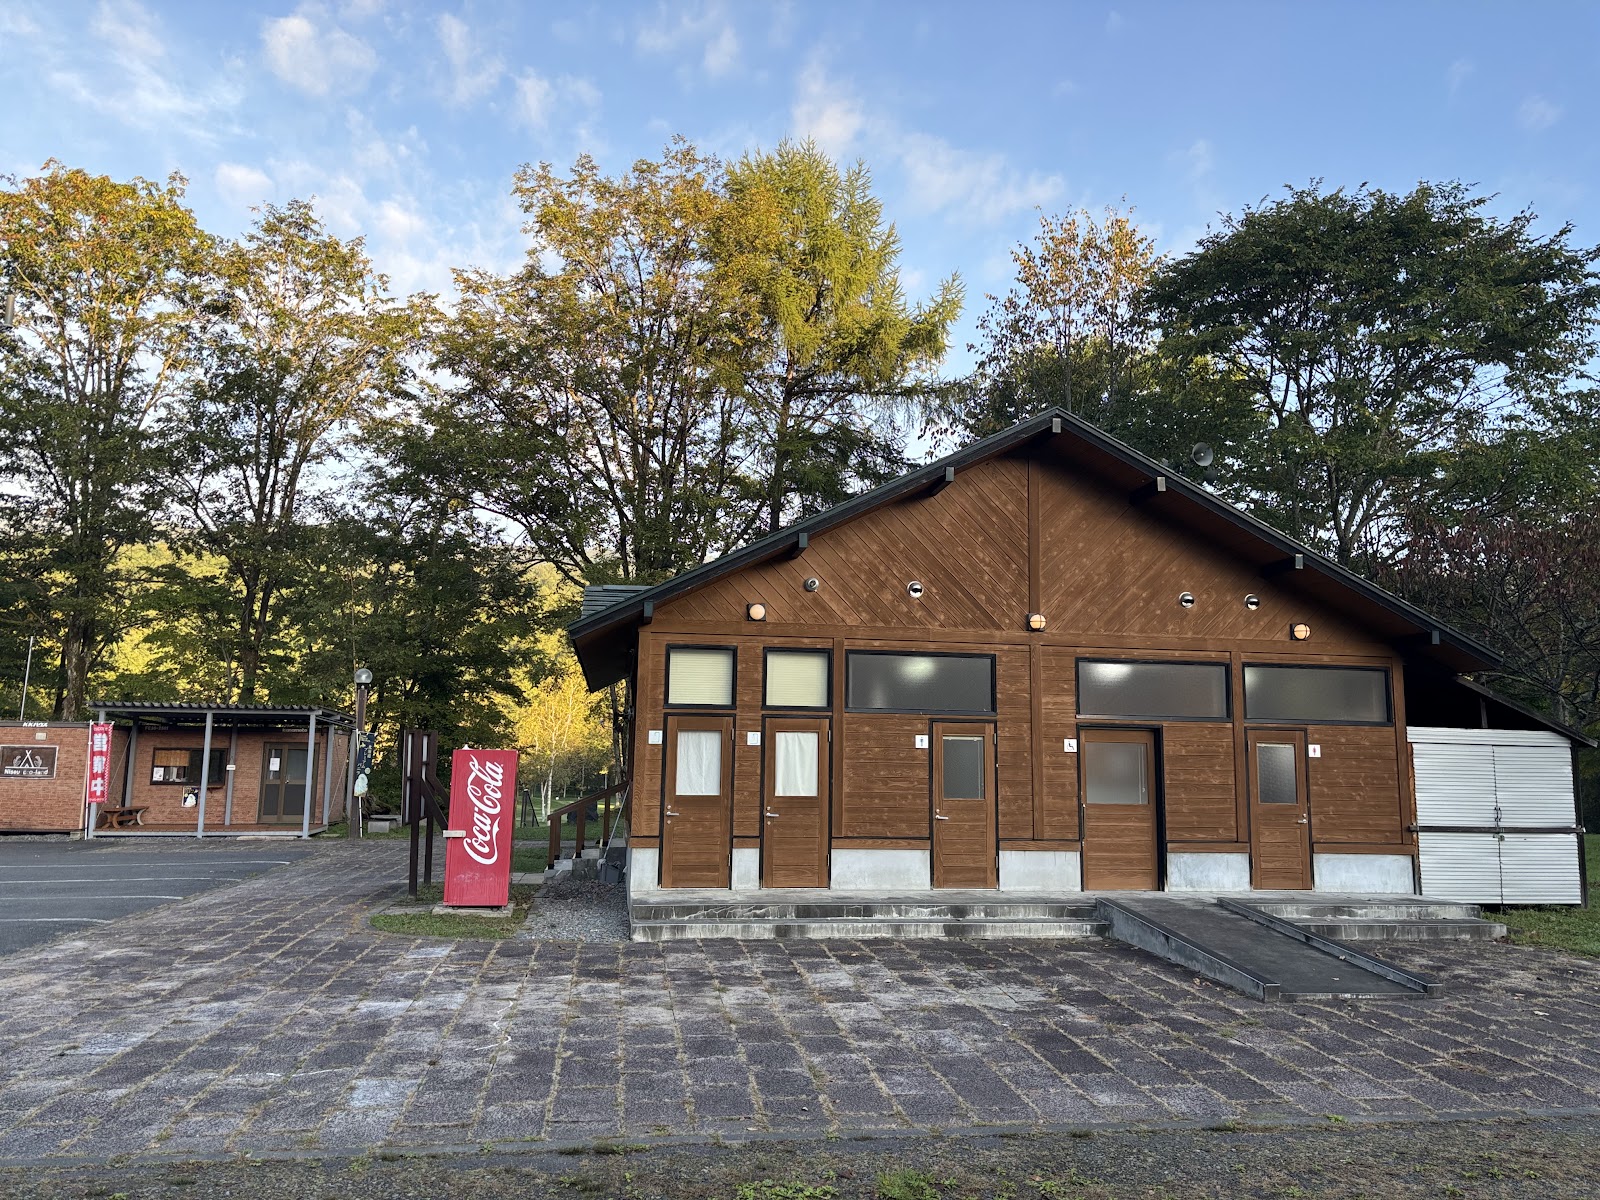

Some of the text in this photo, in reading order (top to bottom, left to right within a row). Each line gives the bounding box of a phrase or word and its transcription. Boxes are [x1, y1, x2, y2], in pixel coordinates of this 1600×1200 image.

[91, 733, 108, 796] 営業中
[463, 754, 504, 865] Coca-Cola
